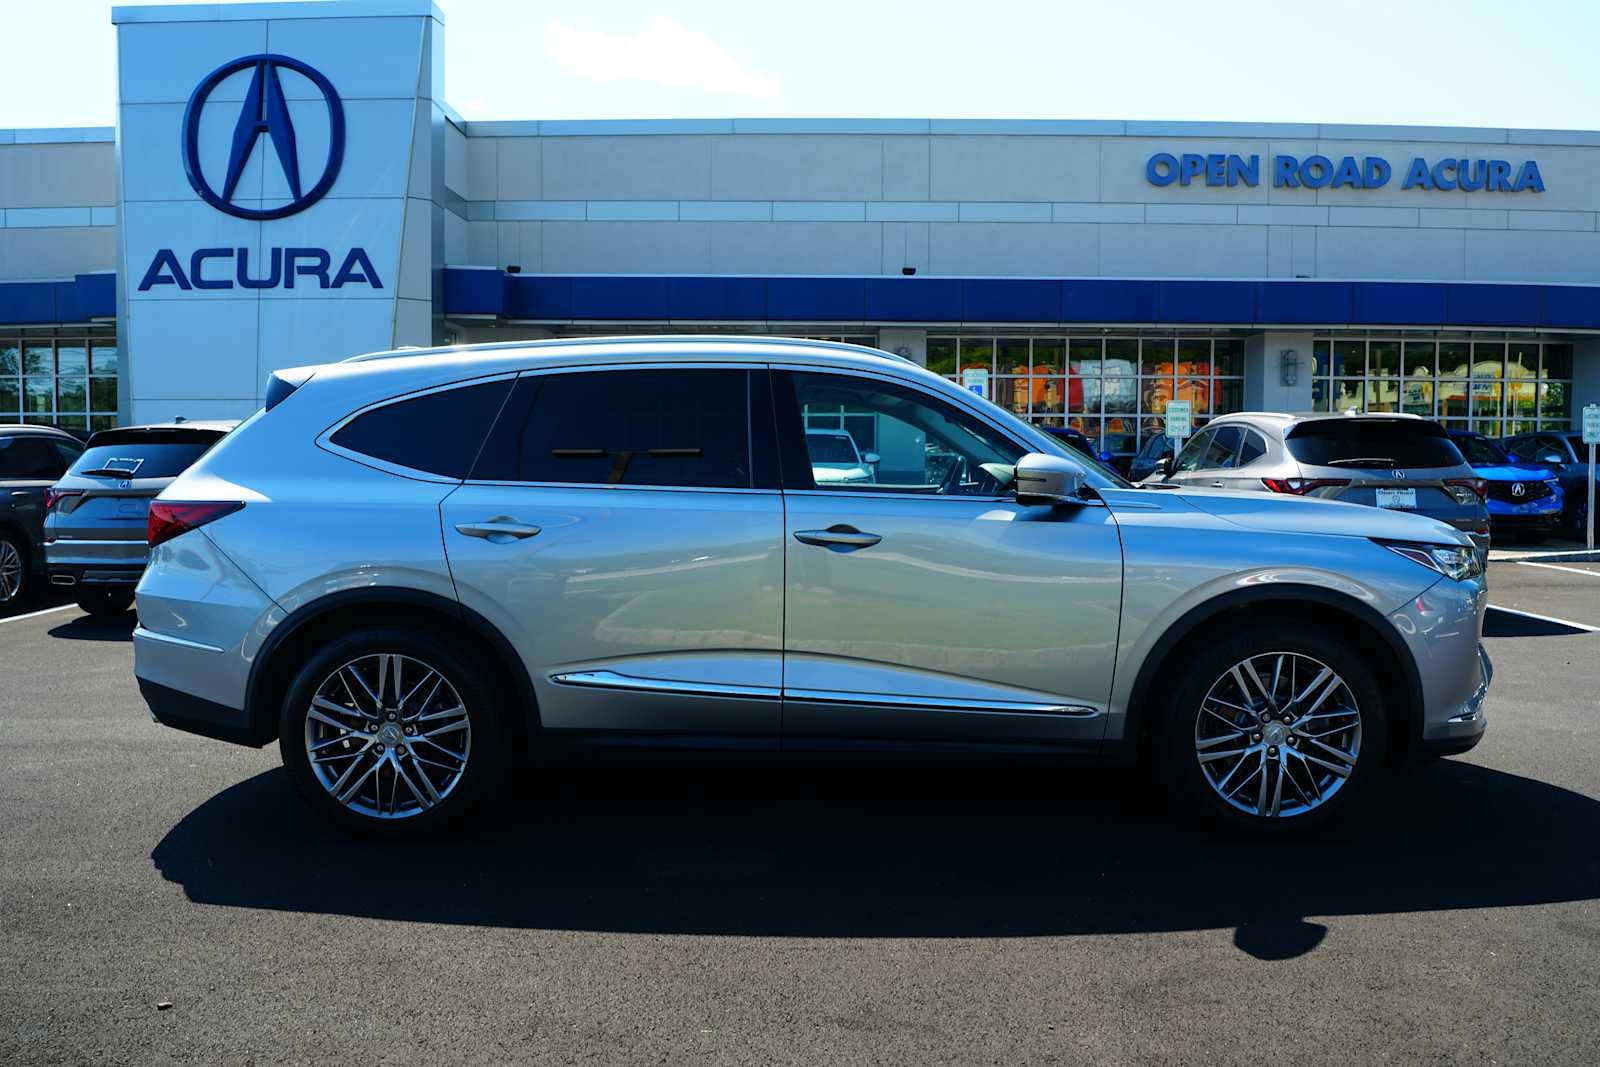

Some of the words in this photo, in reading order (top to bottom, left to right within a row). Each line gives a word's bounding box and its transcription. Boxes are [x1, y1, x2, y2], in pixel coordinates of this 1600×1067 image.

[1146, 153, 1260, 187] OPEN
[1273, 156, 1392, 190] ROAD
[1401, 158, 1546, 193] ACURA
[138, 248, 384, 291] ACURA
